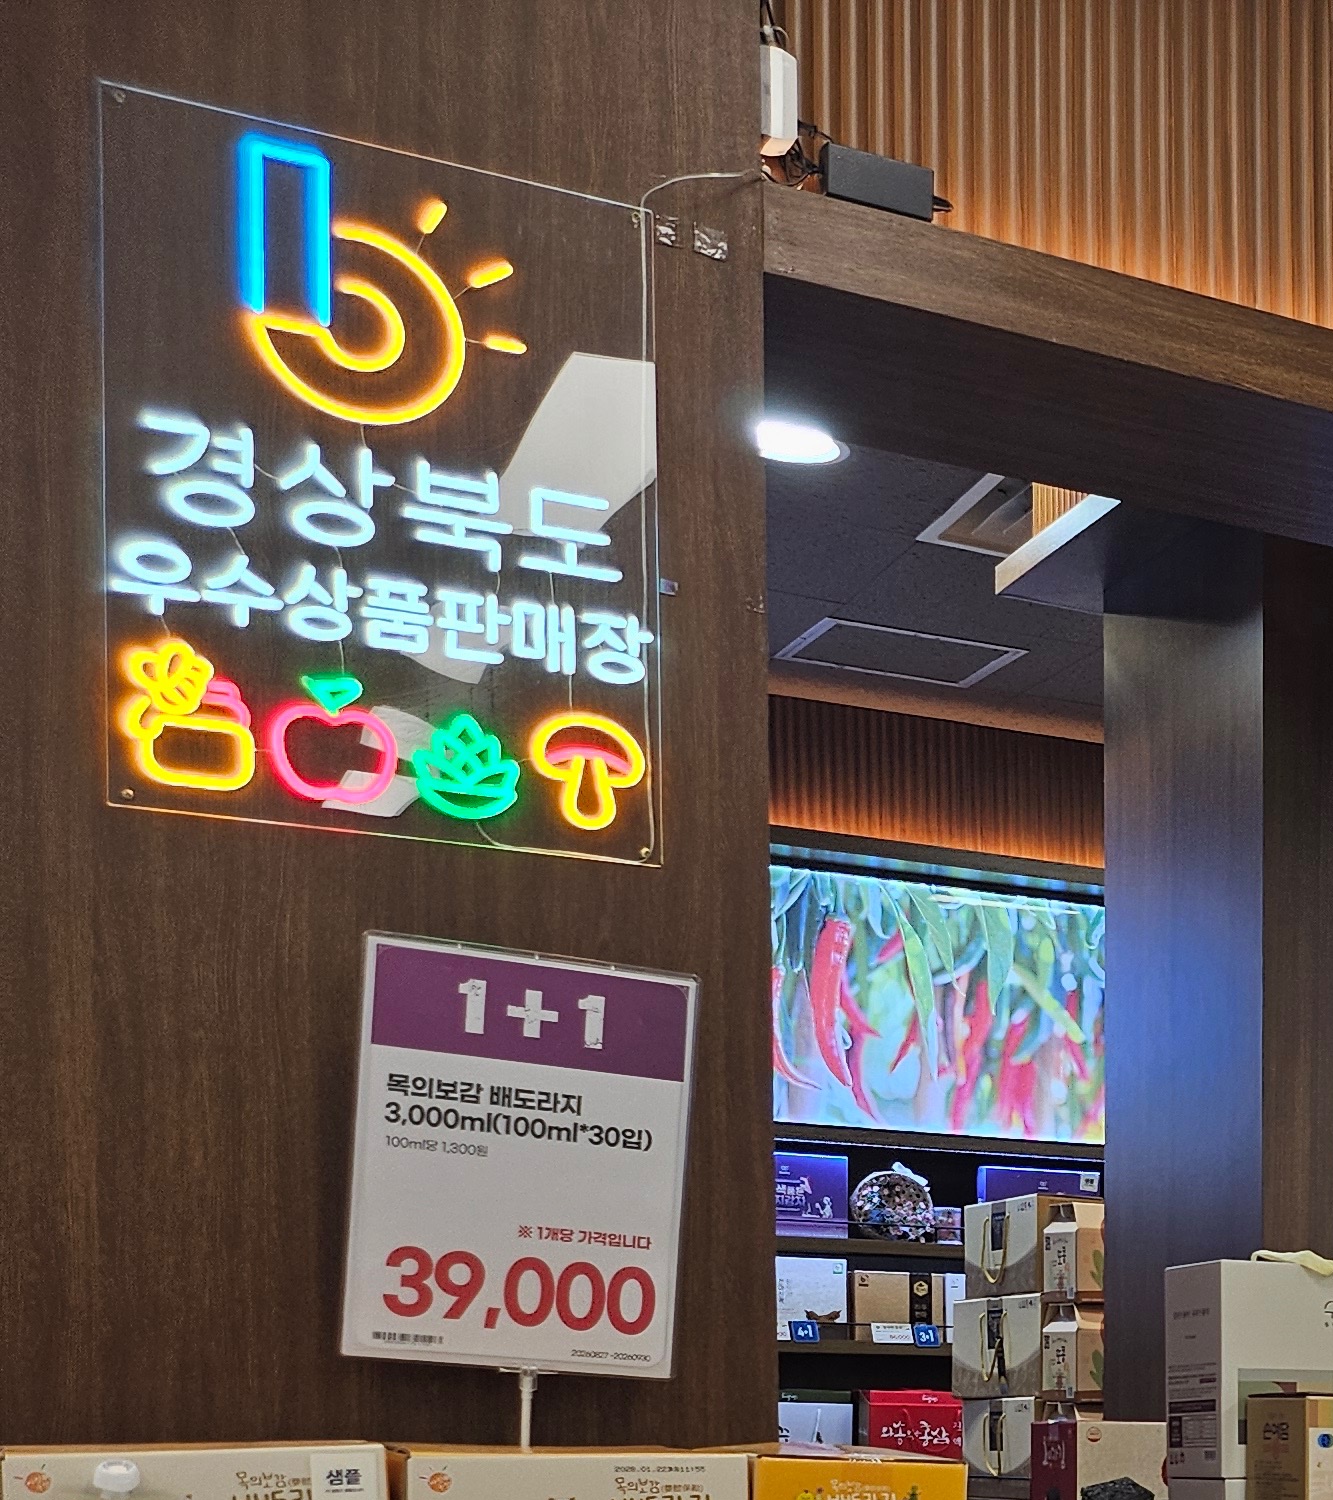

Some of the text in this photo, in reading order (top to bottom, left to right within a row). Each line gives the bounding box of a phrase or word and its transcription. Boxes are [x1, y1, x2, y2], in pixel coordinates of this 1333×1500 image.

[139, 410, 624, 585] 경상북도
[110, 539, 655, 685] 우수상품판매장
[458, 977, 606, 1050] 1+1
[386, 1073, 583, 1117] 목의보감 배도라지
[537, 1226, 653, 1251] 1개당 가격입니다
[382, 1245, 657, 1336] 39,000
[325, 1467, 363, 1487] 샘플
